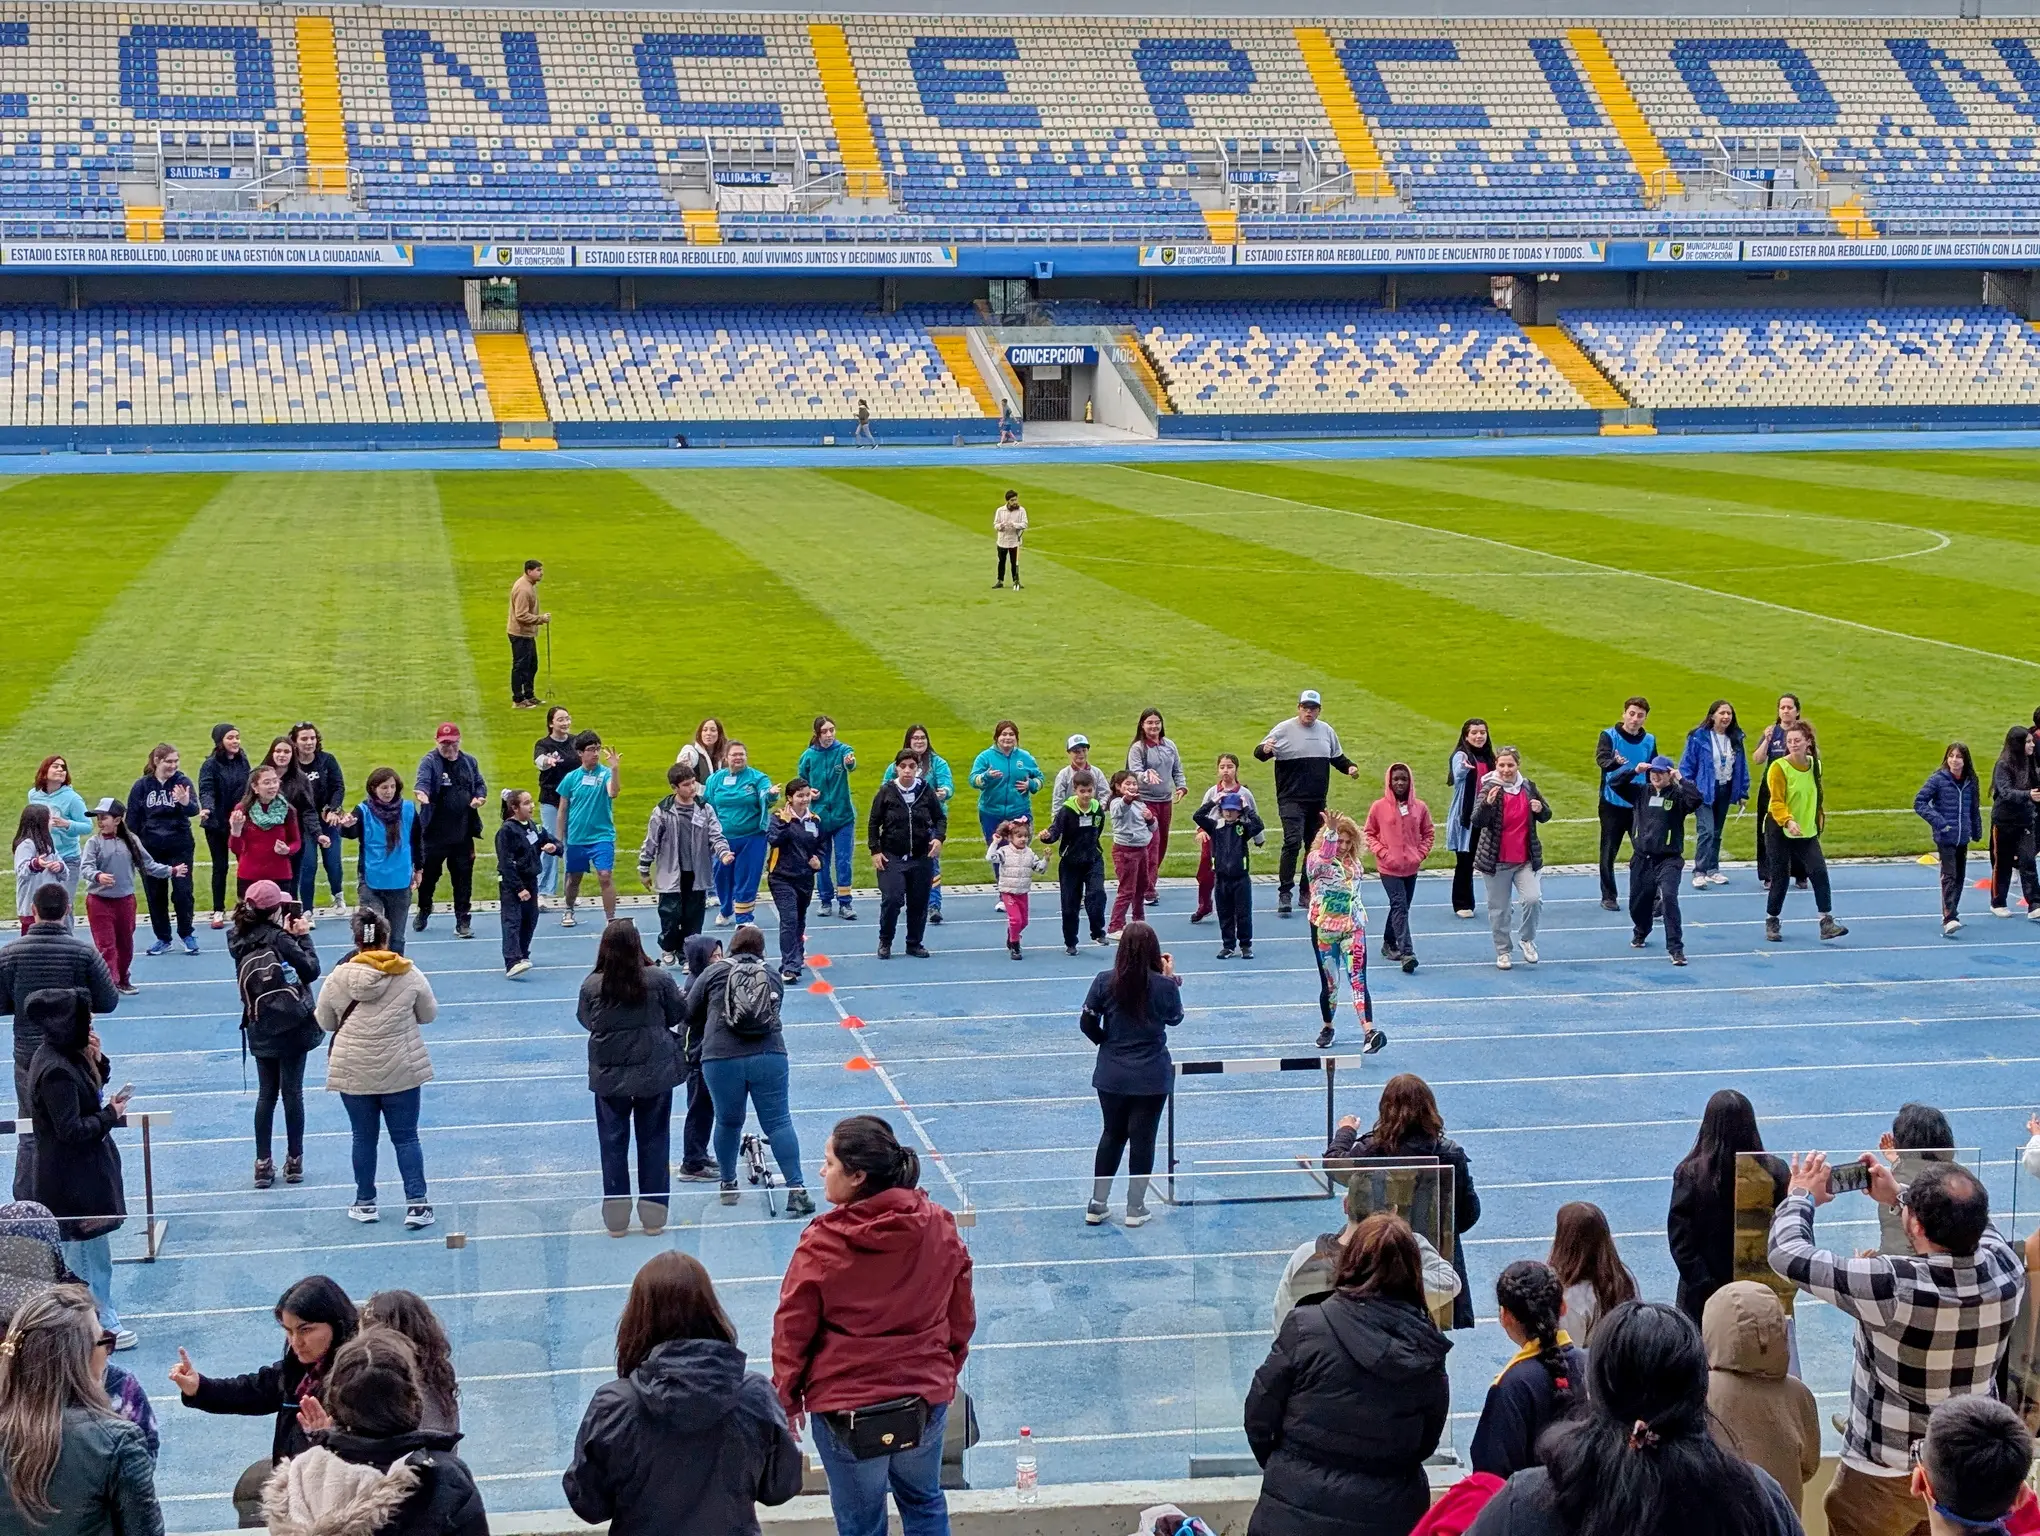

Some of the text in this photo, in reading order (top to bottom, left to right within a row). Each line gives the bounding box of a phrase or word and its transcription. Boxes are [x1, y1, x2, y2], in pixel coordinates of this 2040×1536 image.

[514, 247, 565, 256] MUNICIPALIDAD
[1178, 246, 1226, 255] MUNICIPALIDAD
[1687, 242, 1733, 250] MUNICIPALIDAD
[1752, 242, 2040, 258] ESTADIO ESTER ROA REBOLLEDO, LOGRO DE UNA GESTIÓN CON LA CIU
[11, 248, 383, 264] ESTADIO ESTER ROA REBOLLEDO, LOGRO DE UNA GESTIÓN CON LA CIUDADANÍA.
[586, 249, 934, 266] ESTADIO ESTER ROA REBOLLEDO, AQUÍ VIVIMOS JUNTOS Y DECIDIMOS JUNTOS.
[1188, 254, 1226, 265] CONCEPCIÓN
[1245, 247, 1585, 263] ESTADIO ESTER ROA REBOLLEDO, PUNTO DE ENCUENTRO DE TODAS Y TODOS.
[1695, 249, 1733, 259] CONCEPCIÓN
[524, 255, 565, 266] CONCEPCIÓN
[1012, 347, 1084, 364] CONCEPCIÓN
